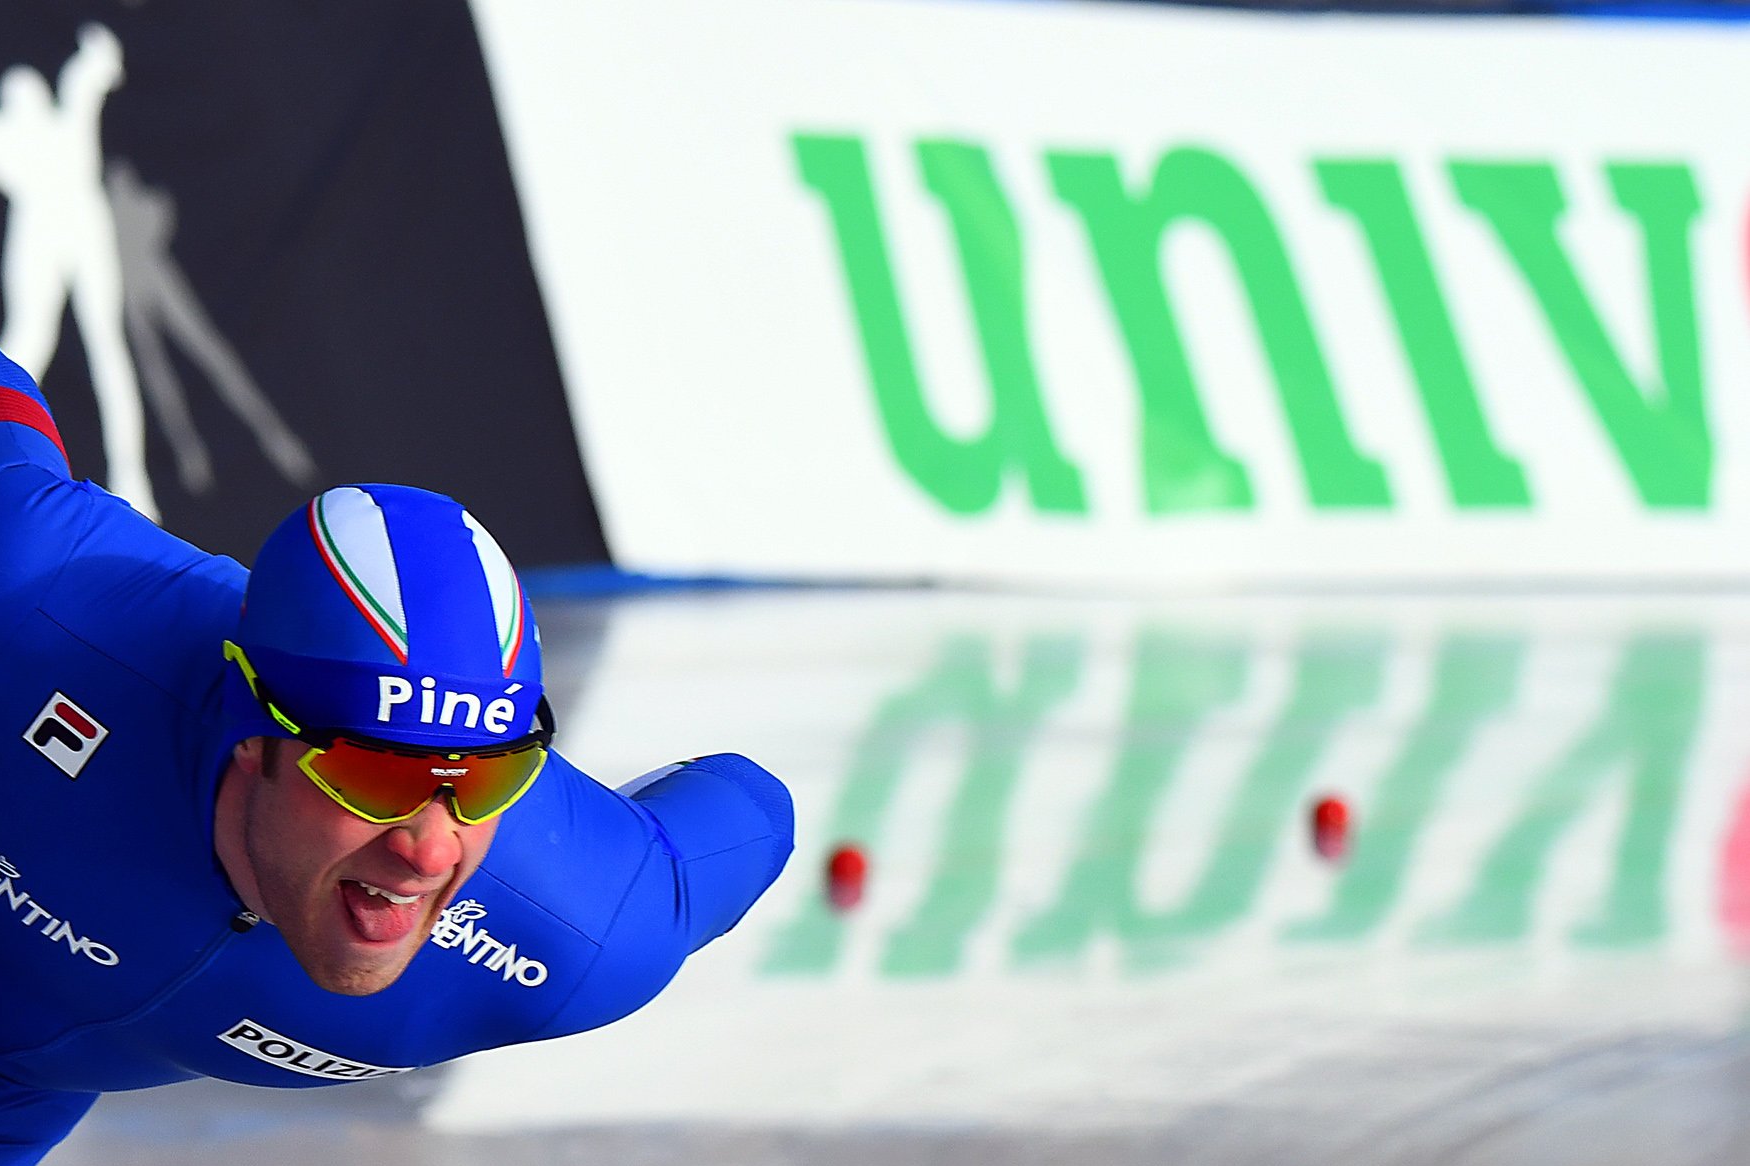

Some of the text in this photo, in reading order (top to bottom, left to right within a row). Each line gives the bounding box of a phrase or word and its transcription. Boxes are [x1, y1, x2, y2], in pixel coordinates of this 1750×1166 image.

[788, 130, 1750, 518] univ
[377, 676, 523, 734] Piné
[430, 908, 548, 987] RENTINO
[226, 1024, 399, 1078] POLIZI
